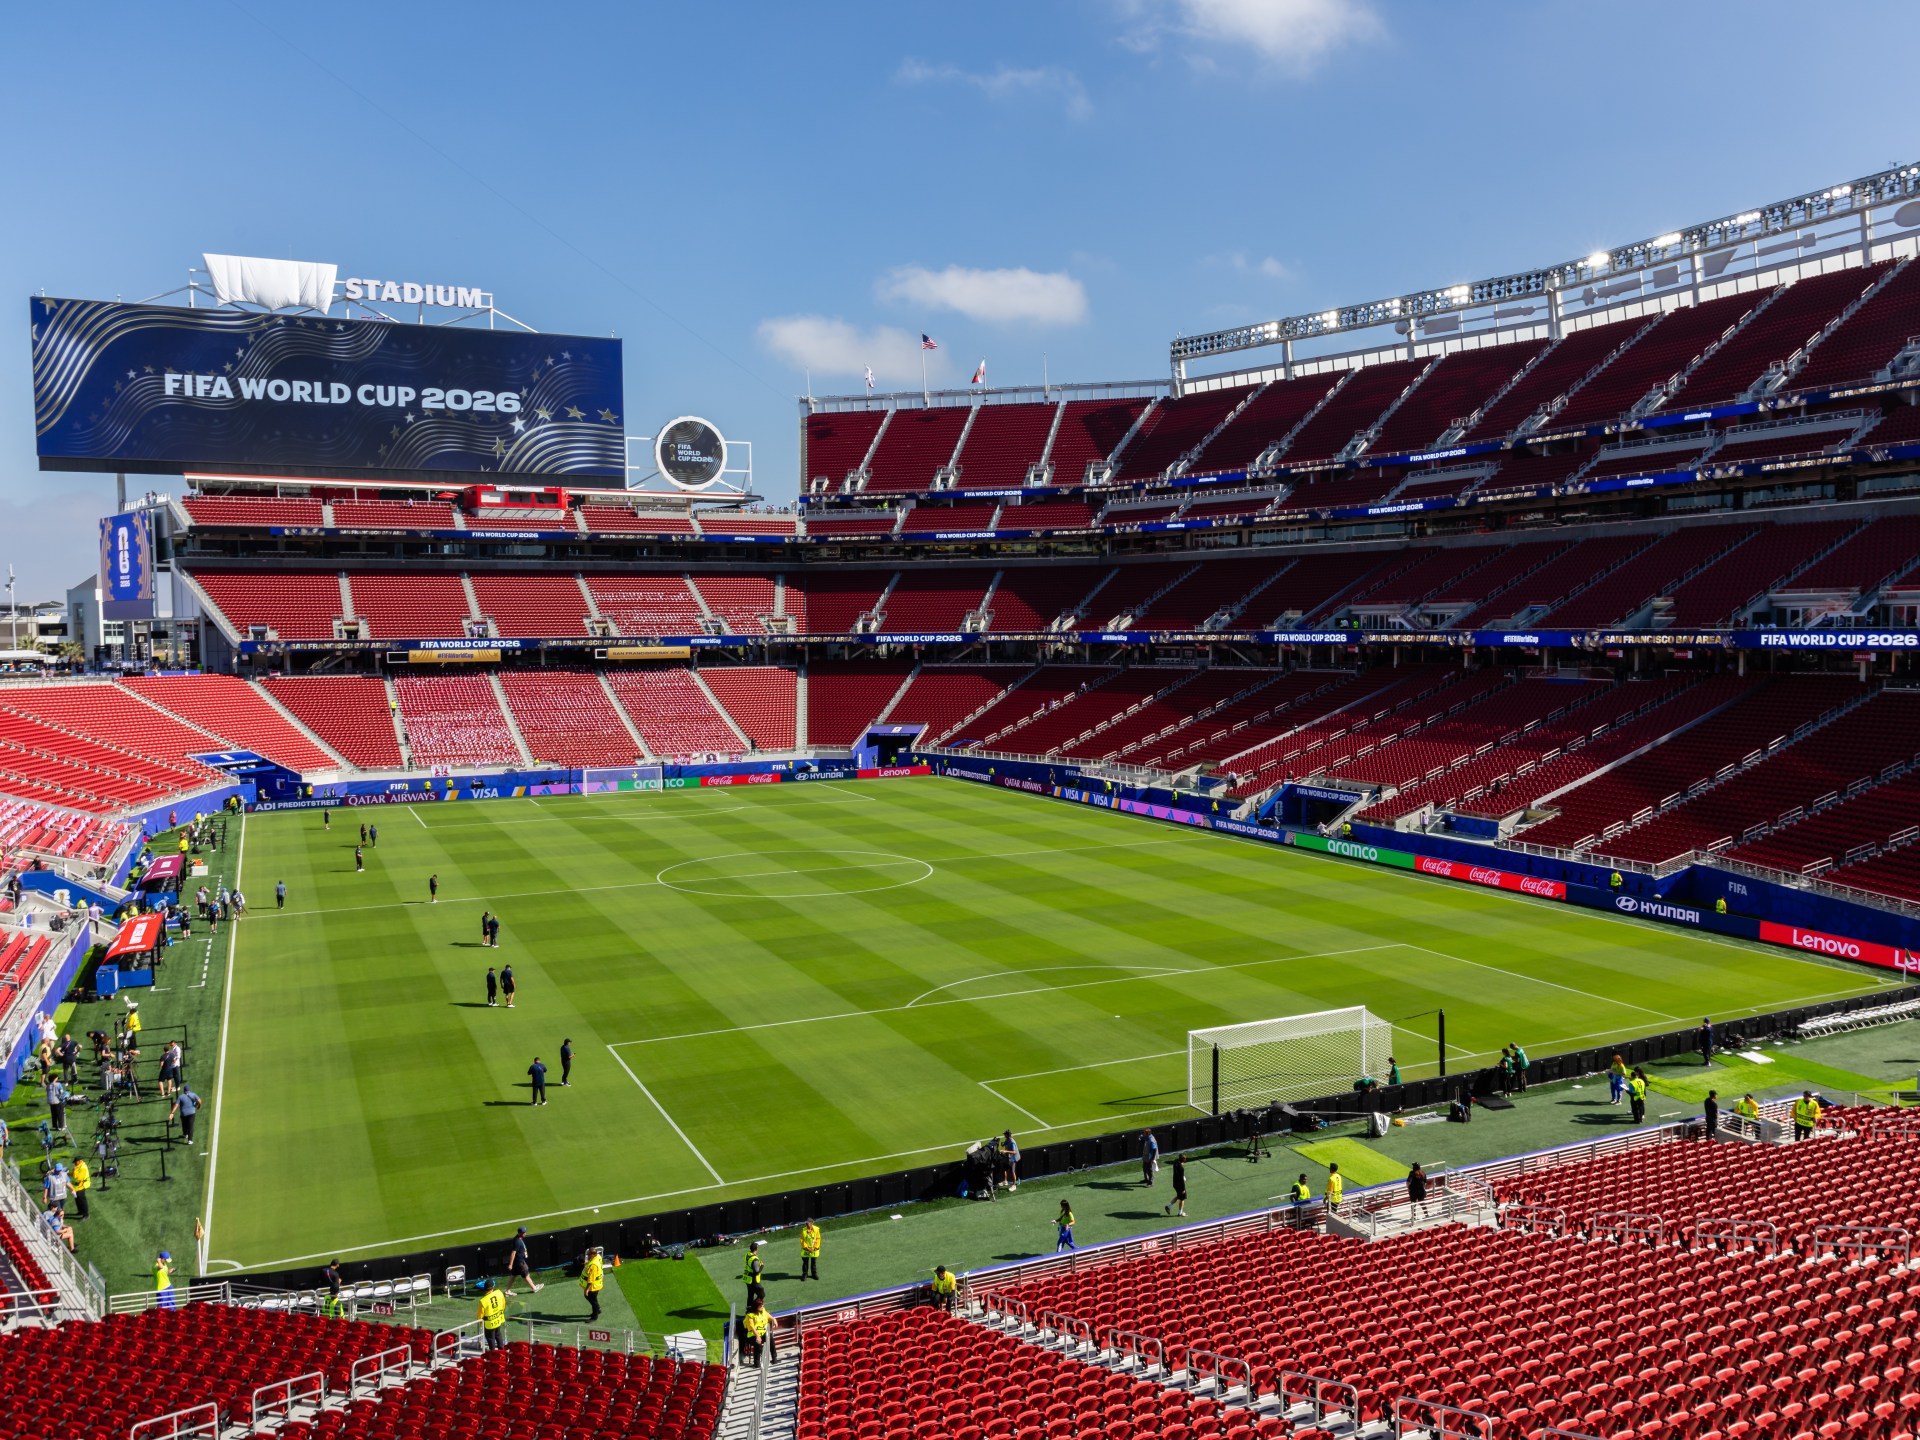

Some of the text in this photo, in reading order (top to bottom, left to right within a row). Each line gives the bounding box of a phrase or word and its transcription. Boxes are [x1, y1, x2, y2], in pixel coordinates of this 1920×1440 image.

[346, 278, 482, 308] STADIUM
[164, 374, 521, 413] FIFA WORLD CUP 2026
[1423, 452, 1439, 460] WORLD
[1450, 449, 1466, 457] 2026
[1761, 463, 1775, 472] SAN
[1832, 455, 1851, 464] AREA
[1604, 635, 1722, 644] SAN FRANCISCO BAY AREA
[1761, 634, 1918, 646] FIFA WORLD CUP 2026
[879, 768, 910, 777] Lenovo
[961, 771, 991, 782] PREDICTSTREET
[1005, 777, 1042, 792] QATAR AIRWAYS
[348, 792, 436, 806] QATAR AIRWAYS
[471, 788, 499, 799] VISA
[1064, 788, 1078, 800] VISA
[1092, 792, 1108, 806] VISA
[1308, 789, 1327, 799] WORLD
[1328, 792, 1338, 800] CUP
[254, 799, 341, 811] ADI PREDICTSTREET
[1216, 820, 1277, 839] FIFA WORLD CUP 2026
[1328, 840, 1378, 861] aramco
[1728, 881, 1747, 896] FIFA
[1641, 901, 1699, 924] HYUNDAI
[1792, 929, 1860, 957] Lenovo
[1142, 1241, 1156, 1250] 128
[376, 1306, 392, 1315] 131
[838, 1310, 856, 1320] 129
[592, 1332, 607, 1340] 130
